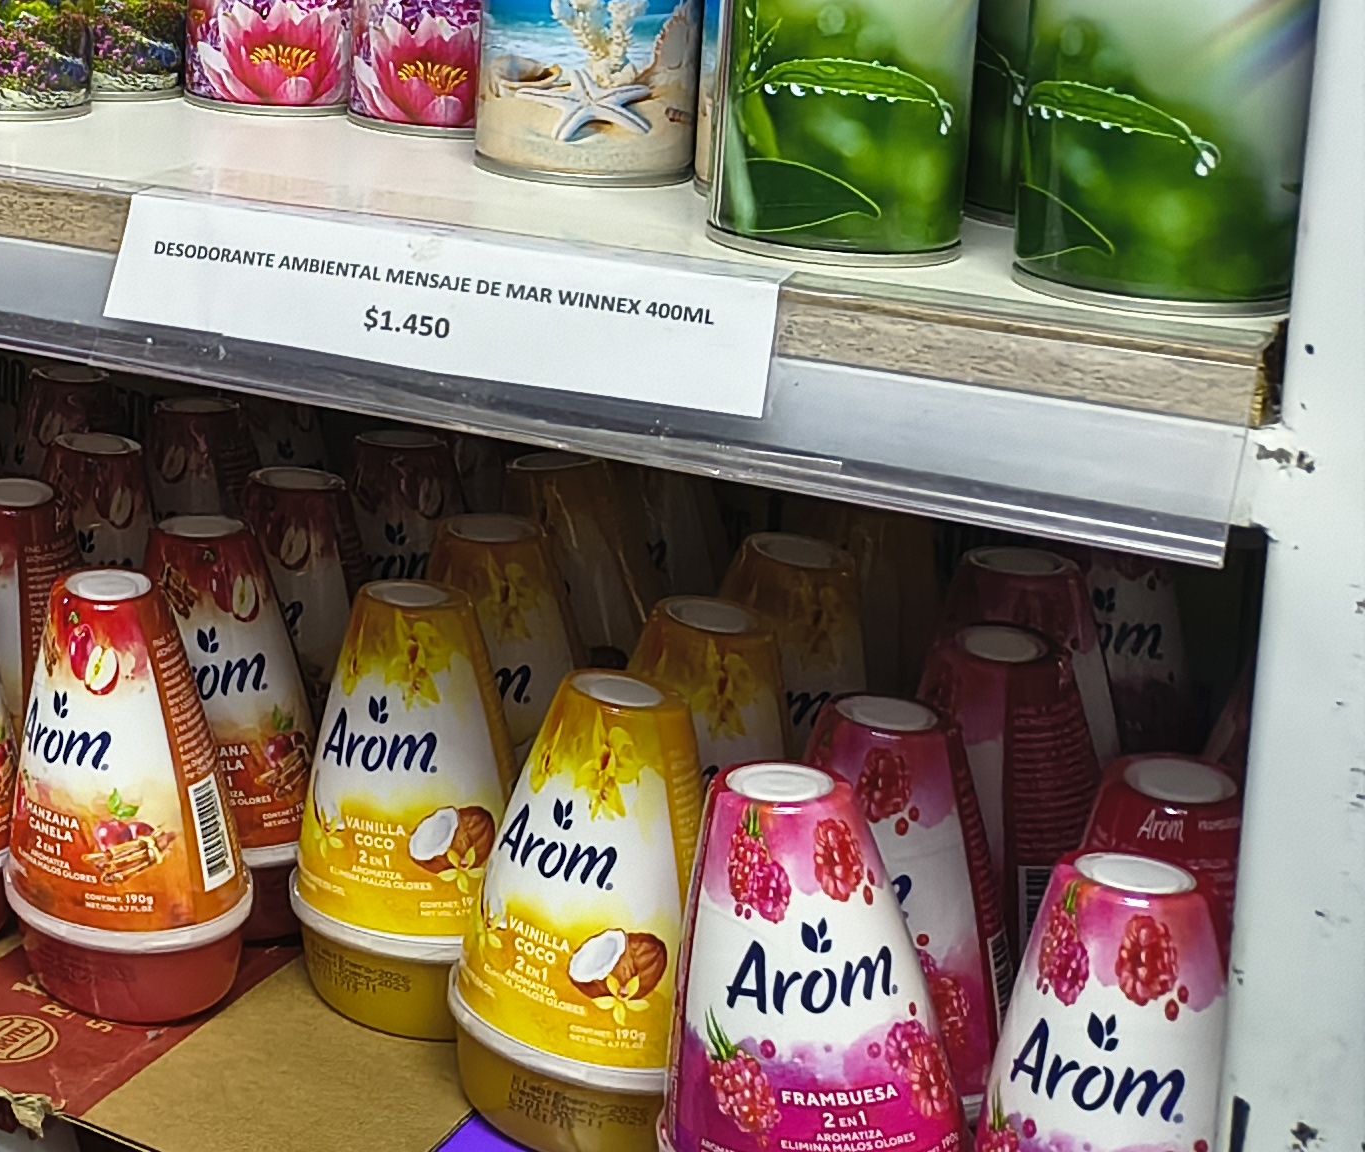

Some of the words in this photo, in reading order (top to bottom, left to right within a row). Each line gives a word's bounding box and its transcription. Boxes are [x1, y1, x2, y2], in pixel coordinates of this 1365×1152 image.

[153, 240, 275, 268] DESODORANTE
[278, 255, 382, 282] AMBIENTAL
[385, 268, 471, 294] MENSAJE
[476, 278, 502, 297] DE
[506, 283, 553, 305] MAR
[558, 290, 642, 316] WINNEX
[645, 301, 715, 326] 400ML
[363, 305, 450, 340] $1.450
[22, 697, 111, 771] Arom
[322, 707, 438, 773] Arom
[27, 800, 80, 831] MANZANA
[29, 816, 74, 843] CANELA
[345, 815, 406, 837] VAINILLA
[35, 835, 43, 848] 2
[55, 842, 61, 856] 1
[354, 832, 395, 851] COCO
[499, 803, 618, 890] Arom
[358, 849, 368, 864] 2
[383, 854, 390, 868] 1
[125, 893, 154, 905] 190g
[508, 915, 570, 954] VAINILLA
[514, 936, 557, 965] COCO
[726, 939, 892, 1015] Arom
[1010, 1017, 1185, 1123] Arom
[781, 1083, 899, 1108] FRAMBUESA
[822, 1113, 836, 1129] 2
[837, 1115, 856, 1128] EN
[857, 1111, 868, 1127] 1
[874, 1132, 916, 1150] OLORES
